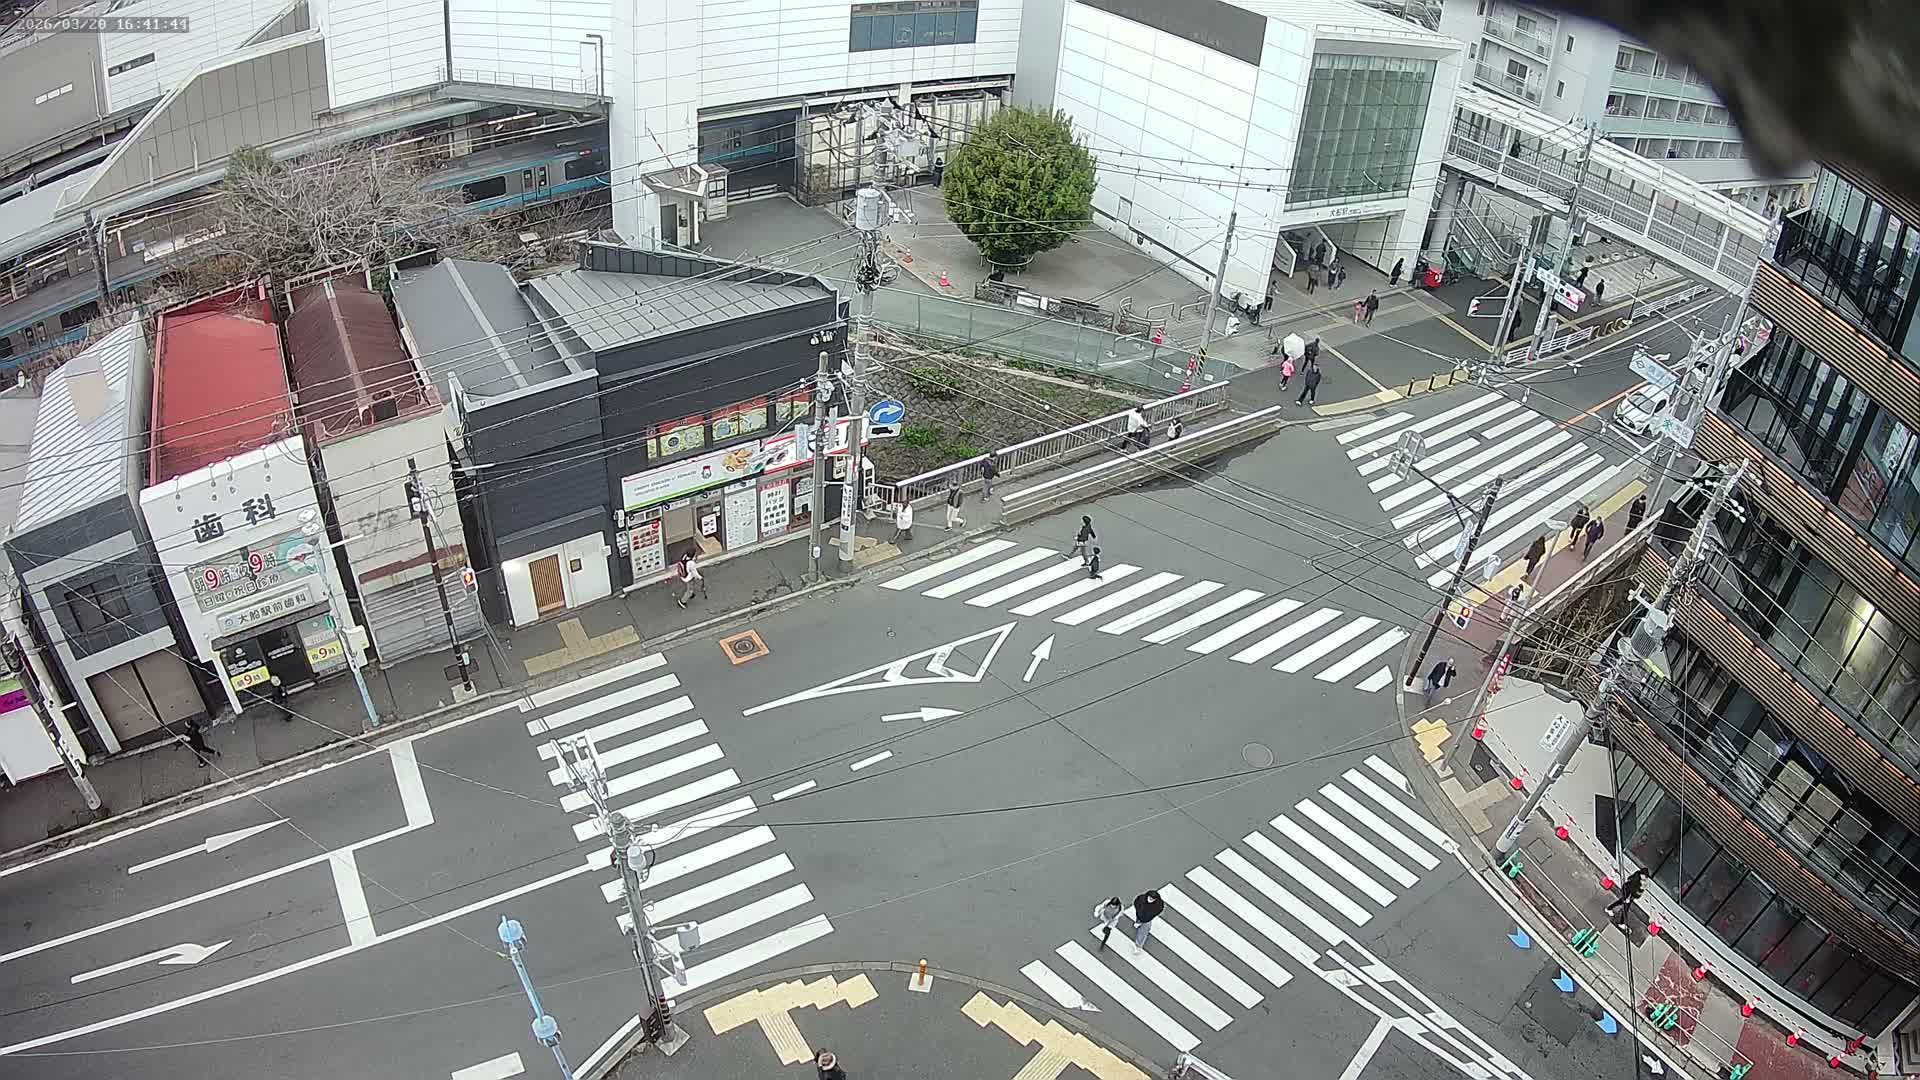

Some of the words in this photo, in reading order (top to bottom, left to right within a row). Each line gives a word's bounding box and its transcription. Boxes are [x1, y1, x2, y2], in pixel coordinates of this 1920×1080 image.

[191, 493, 276, 543] 歯科
[239, 593, 306, 624] 大船駅前歯科
